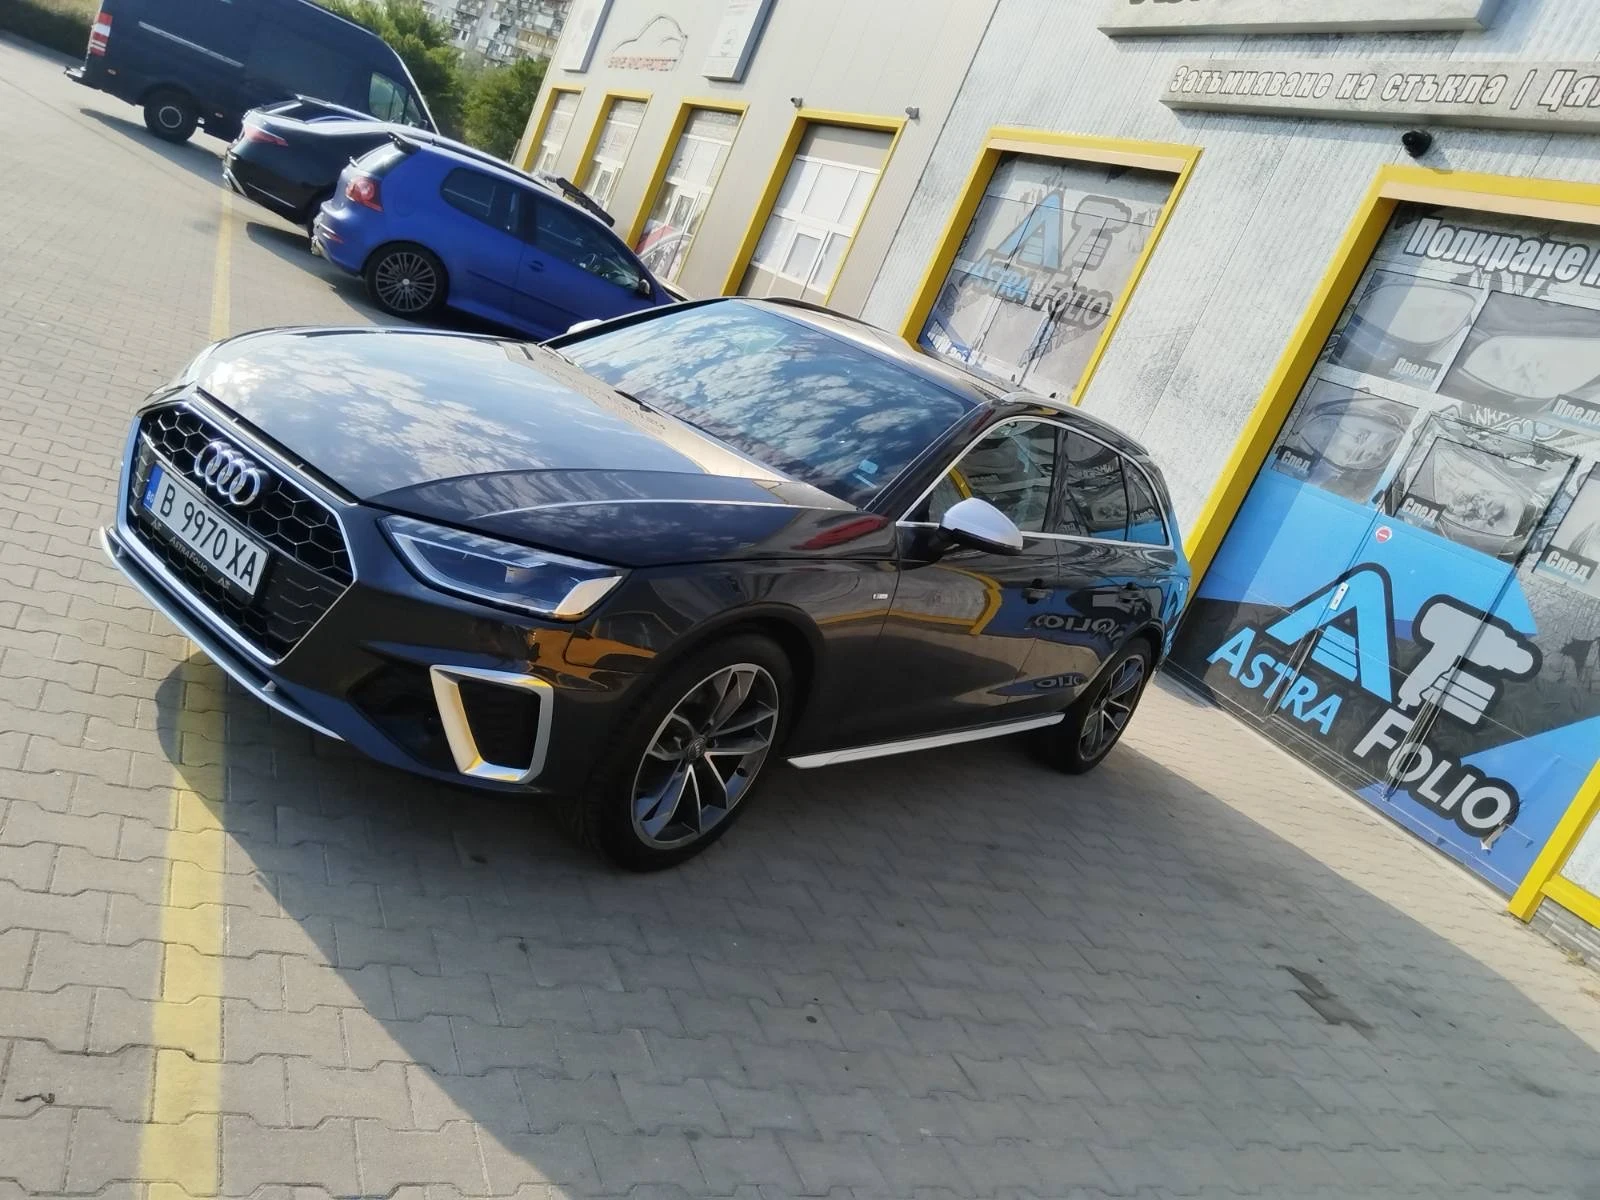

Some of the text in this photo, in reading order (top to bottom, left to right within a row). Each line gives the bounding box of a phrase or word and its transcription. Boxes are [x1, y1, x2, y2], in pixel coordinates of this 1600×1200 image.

[1169, 66, 1334, 98] Затъмняване
[1335, 73, 1378, 100] на
[1381, 74, 1508, 104] стъкла
[1537, 69, 1600, 112] Ця
[1403, 217, 1590, 283] Полиране
[966, 253, 1033, 302] ASTRA
[1392, 357, 1437, 381] Преди
[1281, 450, 1311, 473] След
[1401, 497, 1439, 525] След
[160, 483, 257, 587] B 9970 XA
[1545, 550, 1591, 581] След
[1206, 627, 1343, 735] ASTRA
[1353, 708, 1511, 829] FOLIO
